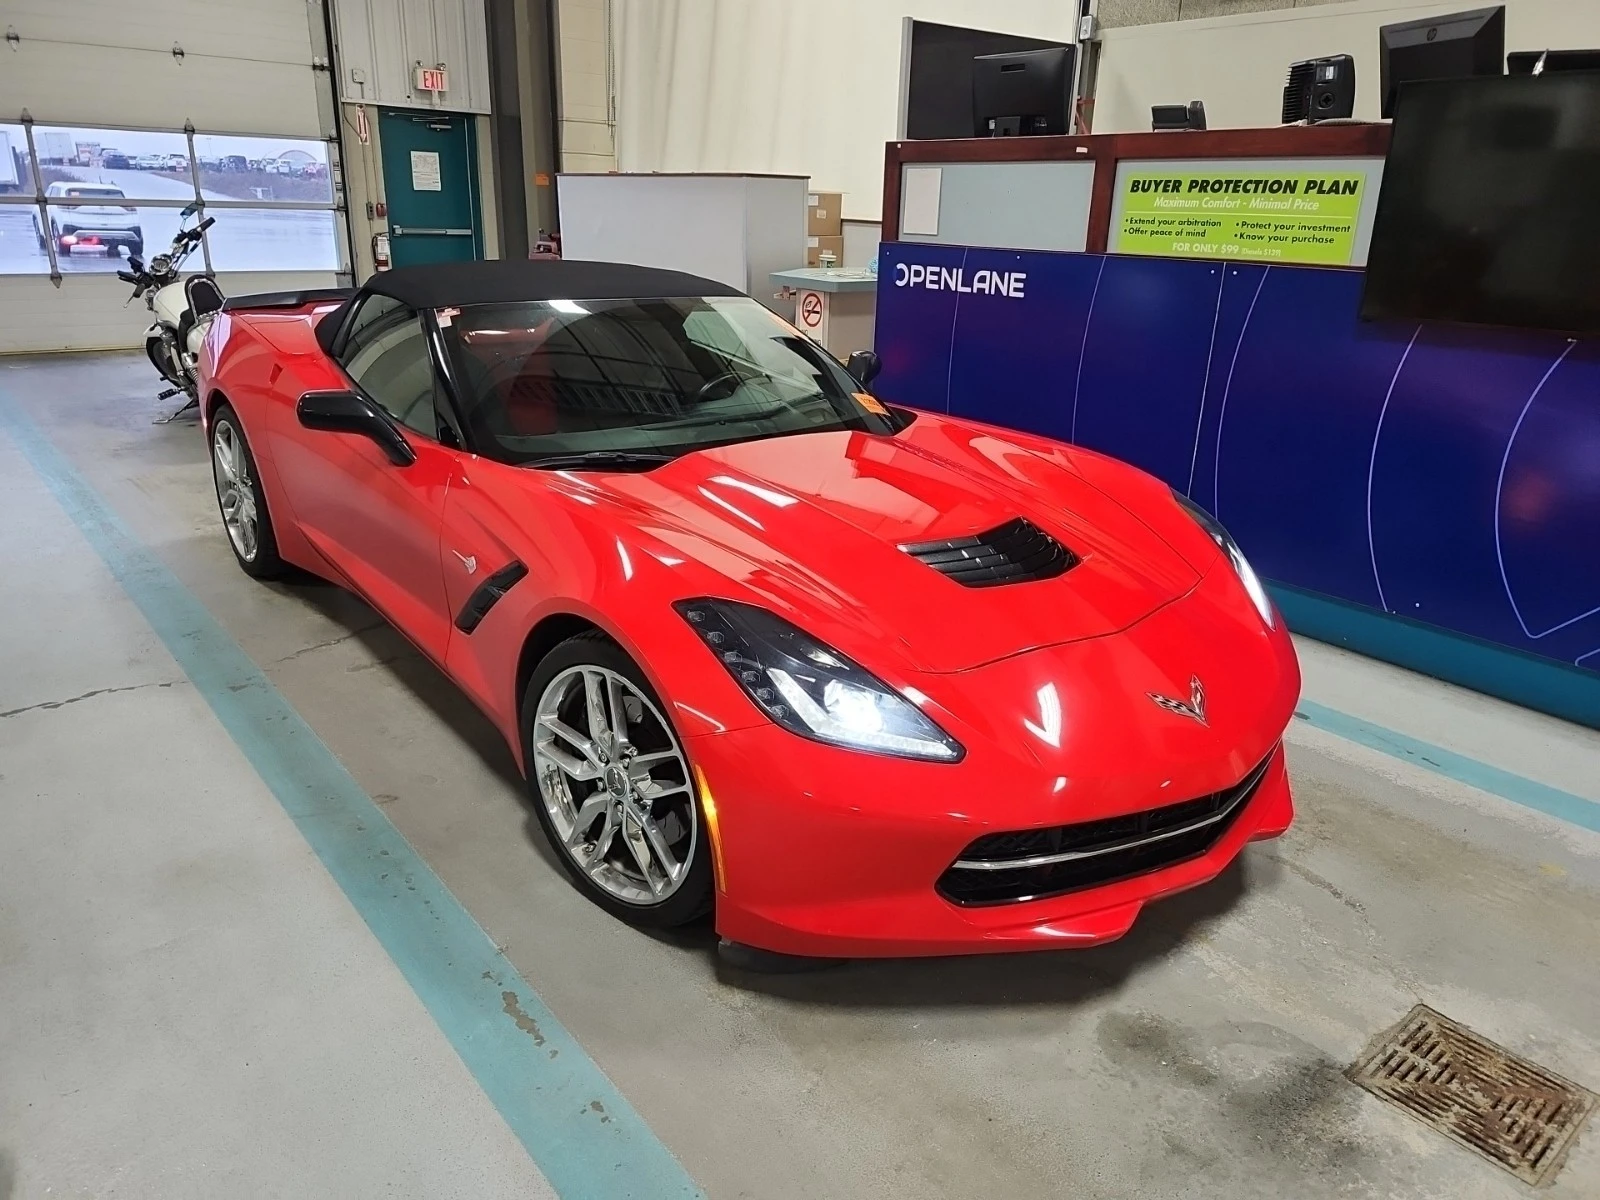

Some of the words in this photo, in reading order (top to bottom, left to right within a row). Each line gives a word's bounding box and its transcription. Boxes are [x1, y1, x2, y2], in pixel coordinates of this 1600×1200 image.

[423, 70, 444, 90] EXIT
[1130, 179, 1183, 194] BUYER
[1187, 179, 1299, 195] PROTECTION
[1303, 180, 1359, 196] PLAN
[1154, 197, 1199, 208] Maximum
[1202, 196, 1240, 209] Comfort
[1249, 197, 1291, 210] Minimal
[1293, 199, 1320, 211] Price
[1129, 217, 1156, 226] Extend
[1157, 219, 1176, 228] your
[1178, 217, 1222, 227] arbitration
[1241, 221, 1271, 230] Protect
[1273, 223, 1295, 232] your
[1297, 222, 1351, 233] investment
[1128, 227, 1148, 235] Offer
[1149, 229, 1173, 238] peace
[1175, 228, 1184, 237] of
[1185, 228, 1206, 238] mind
[1239, 232, 1266, 241] Know
[1267, 234, 1289, 243] your
[1291, 234, 1335, 244] purchase
[1172, 242, 1191, 252] FOR
[1192, 242, 1219, 253] ONLY
[1220, 243, 1239, 255] $99
[893, 262, 1027, 298] OPENLANE
